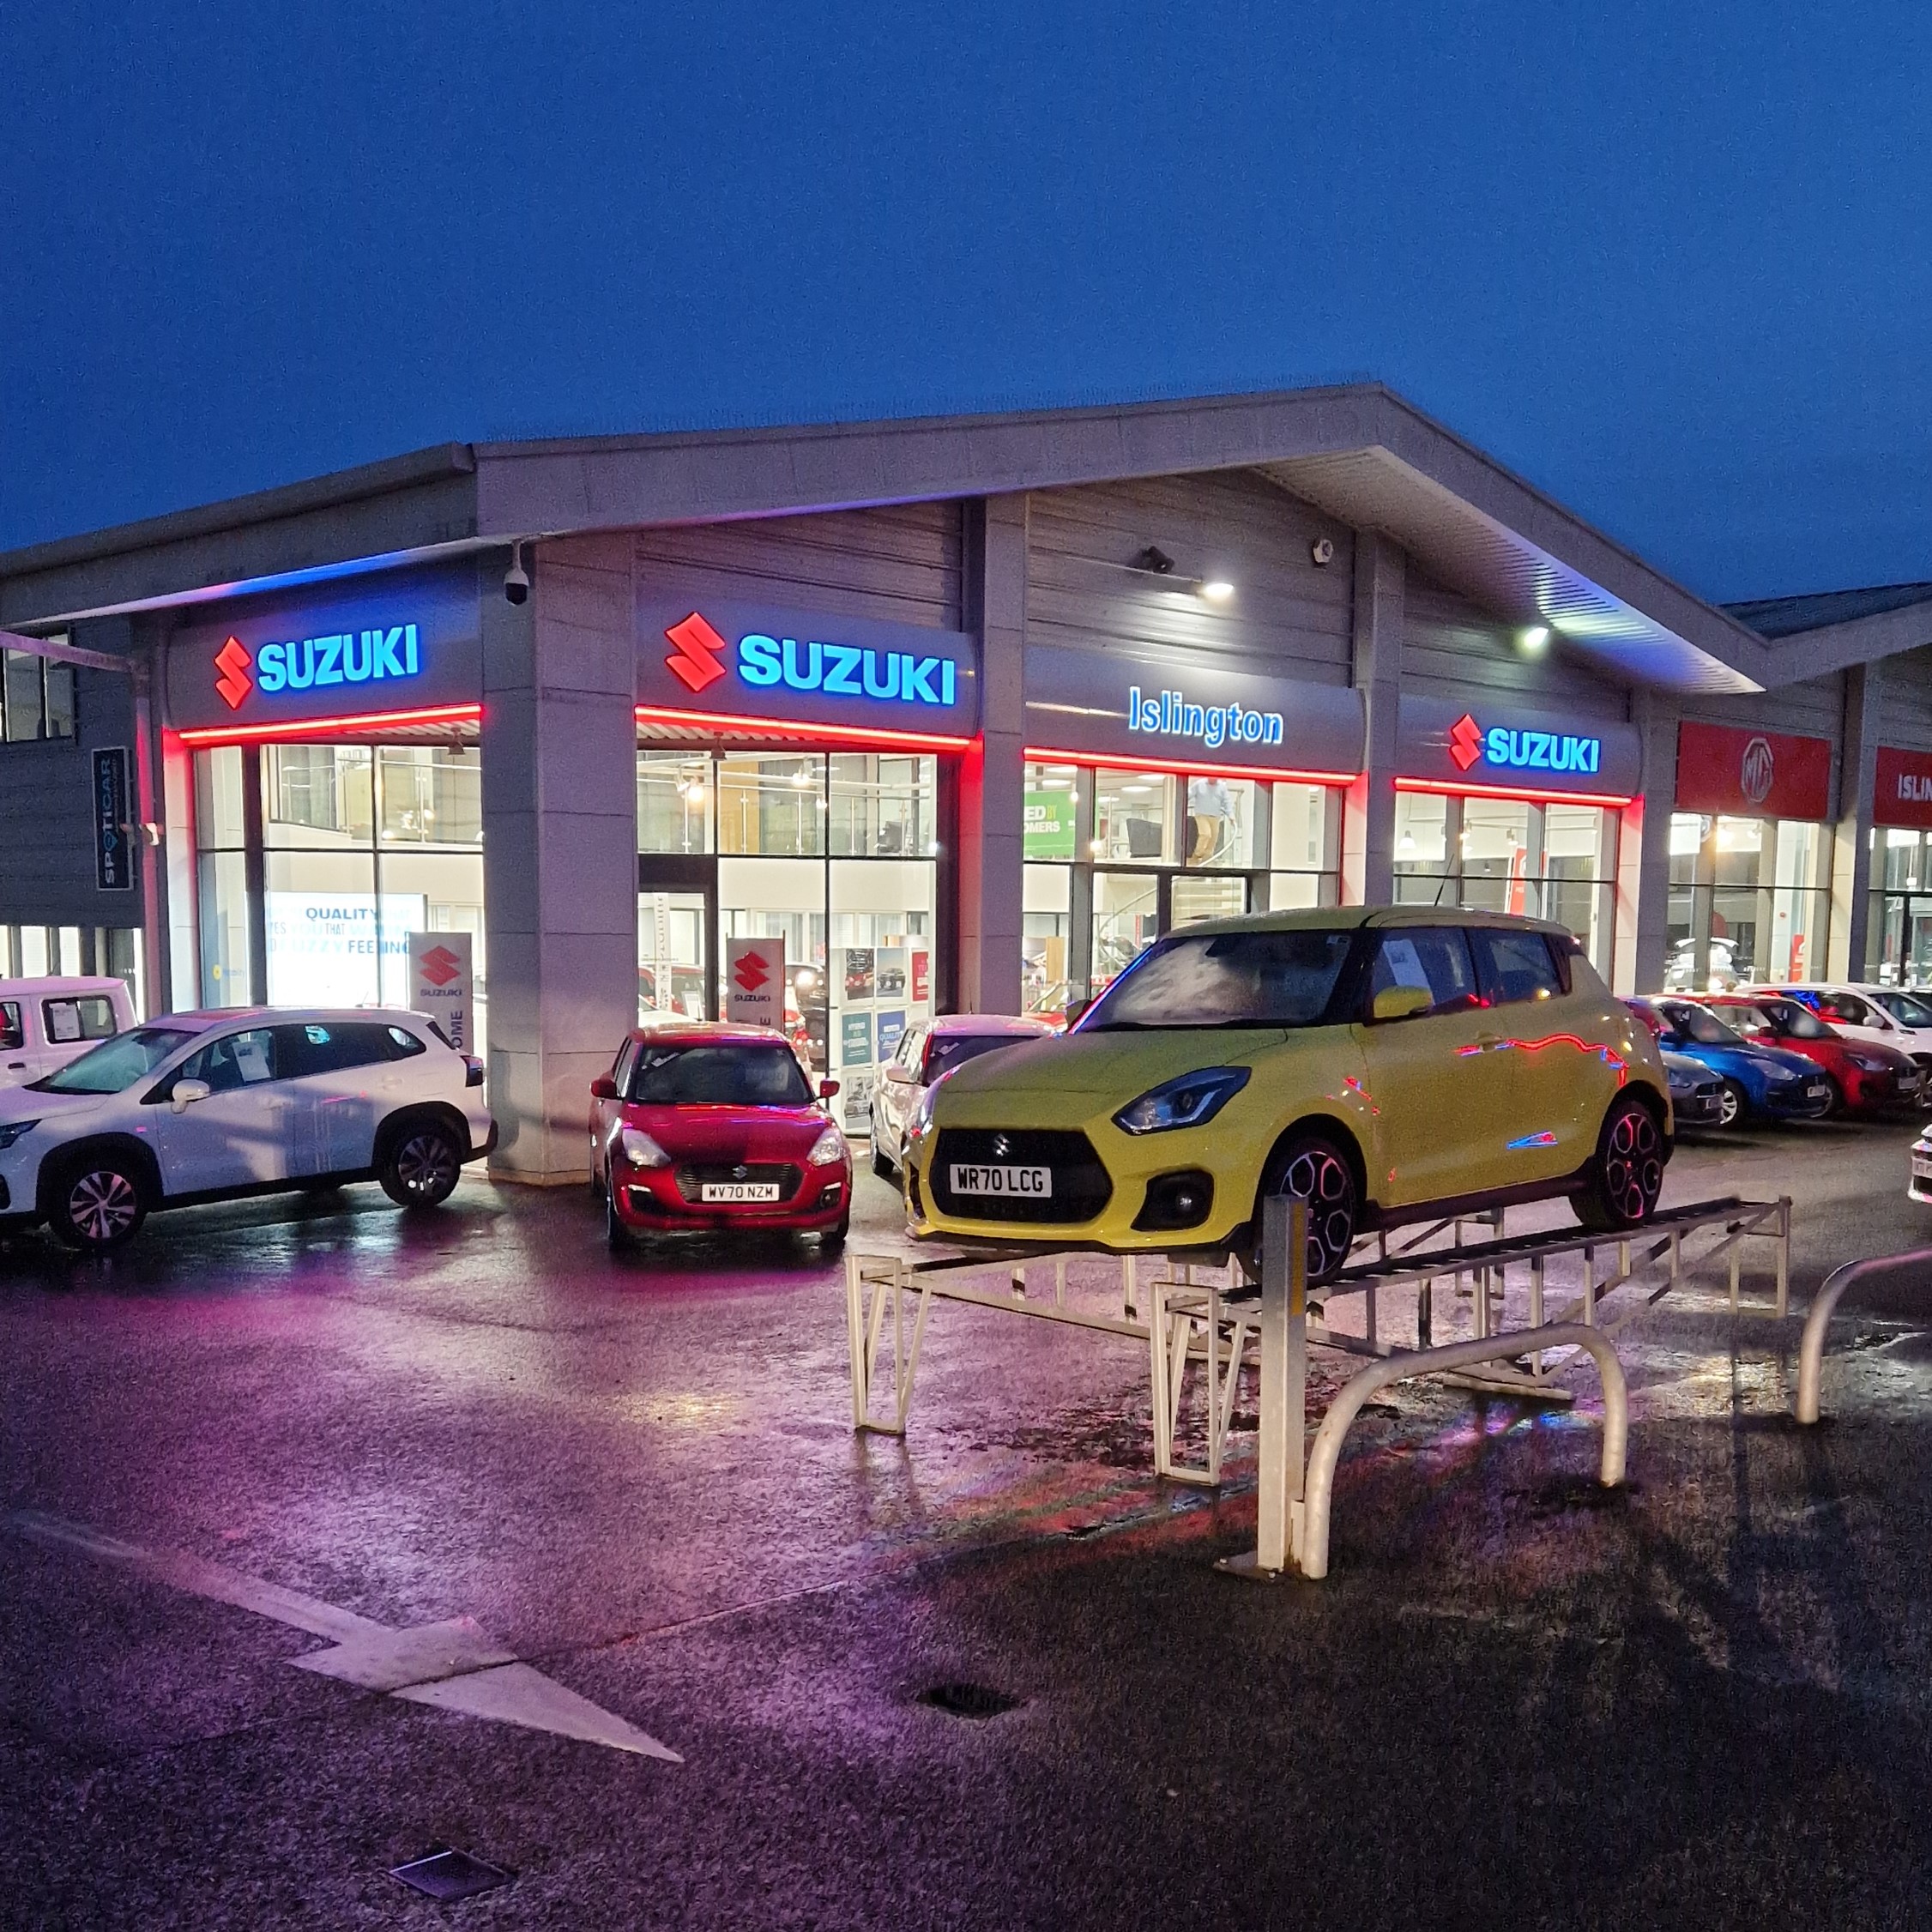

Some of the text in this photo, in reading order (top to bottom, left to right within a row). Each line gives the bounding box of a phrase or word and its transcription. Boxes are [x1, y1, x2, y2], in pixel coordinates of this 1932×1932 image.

[257, 624, 418, 691] SUZUKI
[738, 634, 955, 705] SUZUKI
[1128, 685, 1284, 748] Islington
[1487, 728, 1599, 772] SUZUKI
[325, 923, 346, 935] THAT
[347, 939, 409, 954] FEEING
[420, 988, 462, 997] SUZUKI
[709, 1186, 773, 1198] WV70 NZM
[957, 1168, 1043, 1192] WR70 LCG
